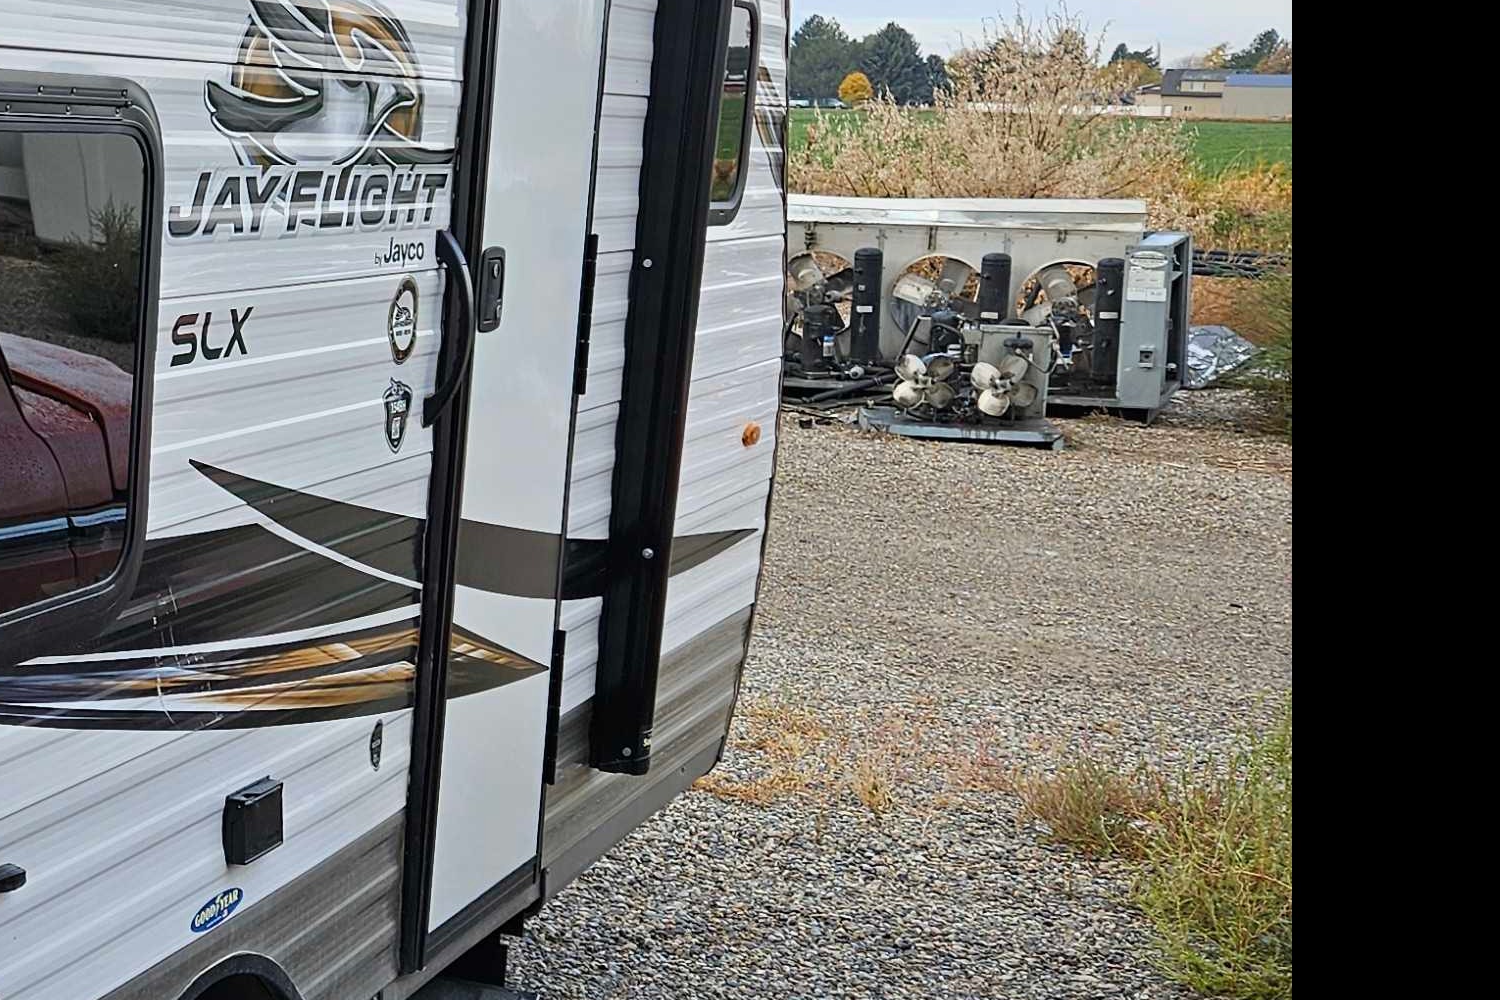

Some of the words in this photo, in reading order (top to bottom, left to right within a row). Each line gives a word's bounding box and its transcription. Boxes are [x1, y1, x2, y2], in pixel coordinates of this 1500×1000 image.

[167, 170, 282, 238] JAY
[285, 169, 449, 233] FLIGHT
[374, 252, 382, 267] by
[384, 236, 424, 267] Jayco
[169, 306, 254, 367] SLX
